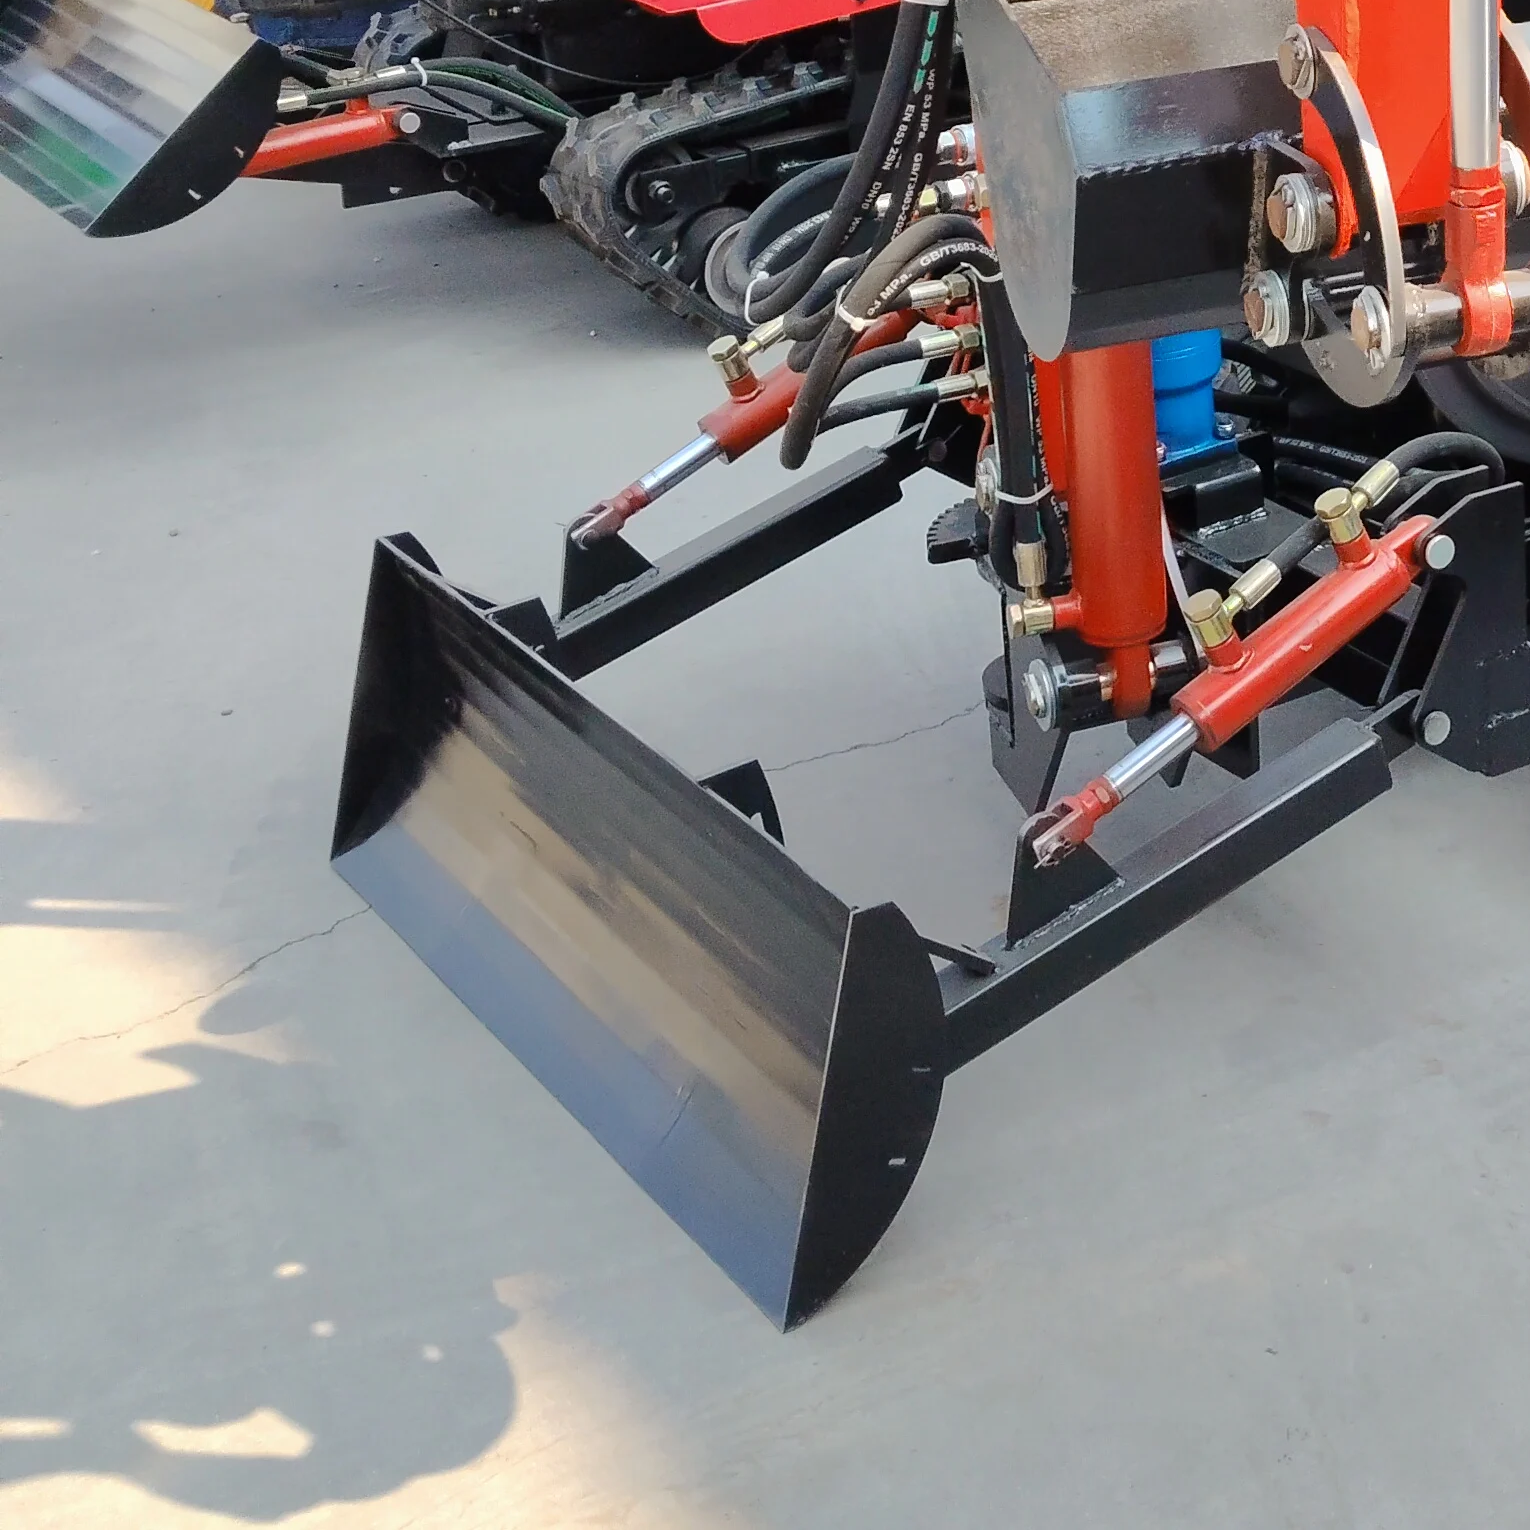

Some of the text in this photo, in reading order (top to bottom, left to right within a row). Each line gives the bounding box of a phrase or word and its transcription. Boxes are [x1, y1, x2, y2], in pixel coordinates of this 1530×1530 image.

[925, 68, 936, 91] WP
[902, 103, 916, 122] EN
[893, 123, 909, 145] 853
[882, 145, 900, 171] 2SN
[861, 181, 882, 210] DN10
[878, 271, 912, 300] MPa.
